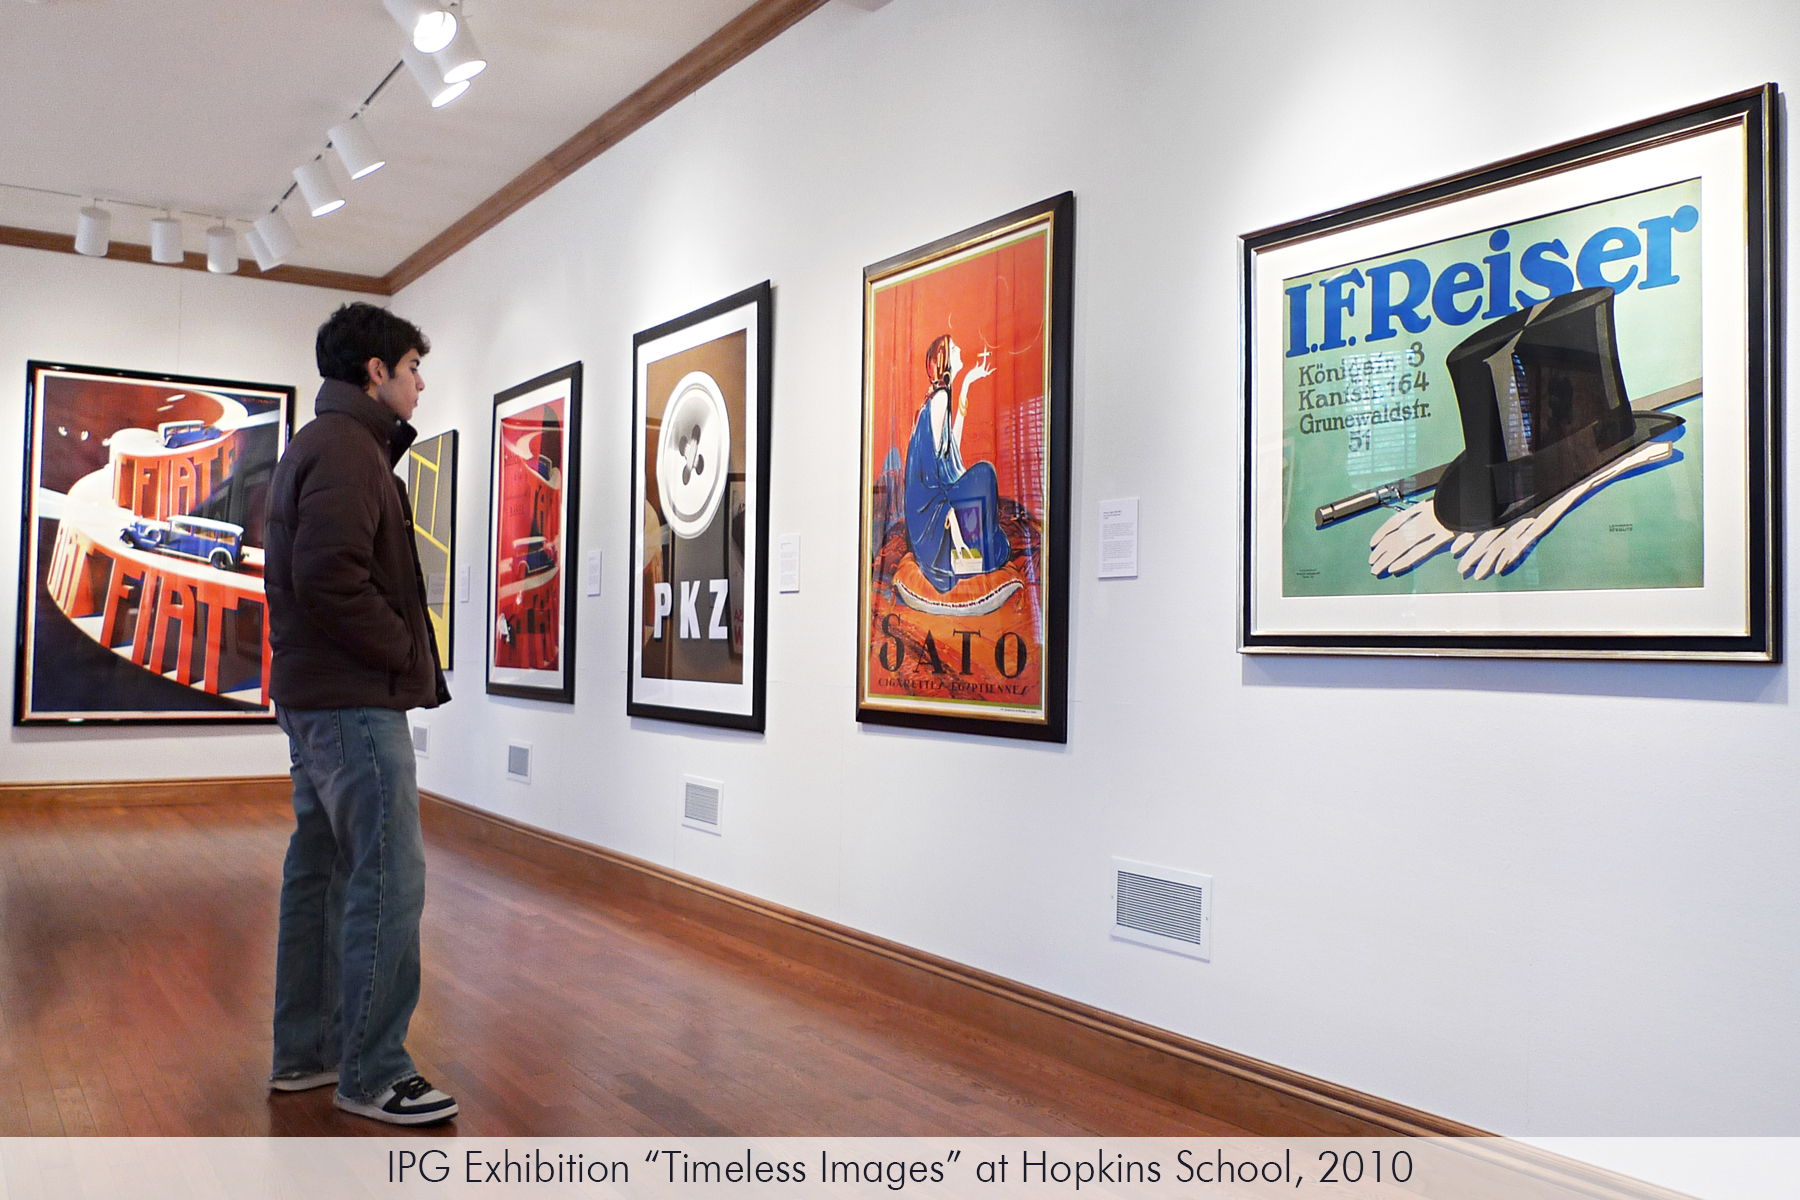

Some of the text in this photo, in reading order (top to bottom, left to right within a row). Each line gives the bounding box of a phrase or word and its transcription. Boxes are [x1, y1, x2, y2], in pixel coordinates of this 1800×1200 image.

[1386, 371, 1429, 396] 164
[1299, 398, 1431, 434] Grunewaldstr.
[1348, 429, 1371, 452] 51
[131, 443, 218, 522] FIAT
[100, 556, 239, 695] FIAT
[653, 578, 729, 640] PKZ
[878, 613, 1028, 679] SATO
